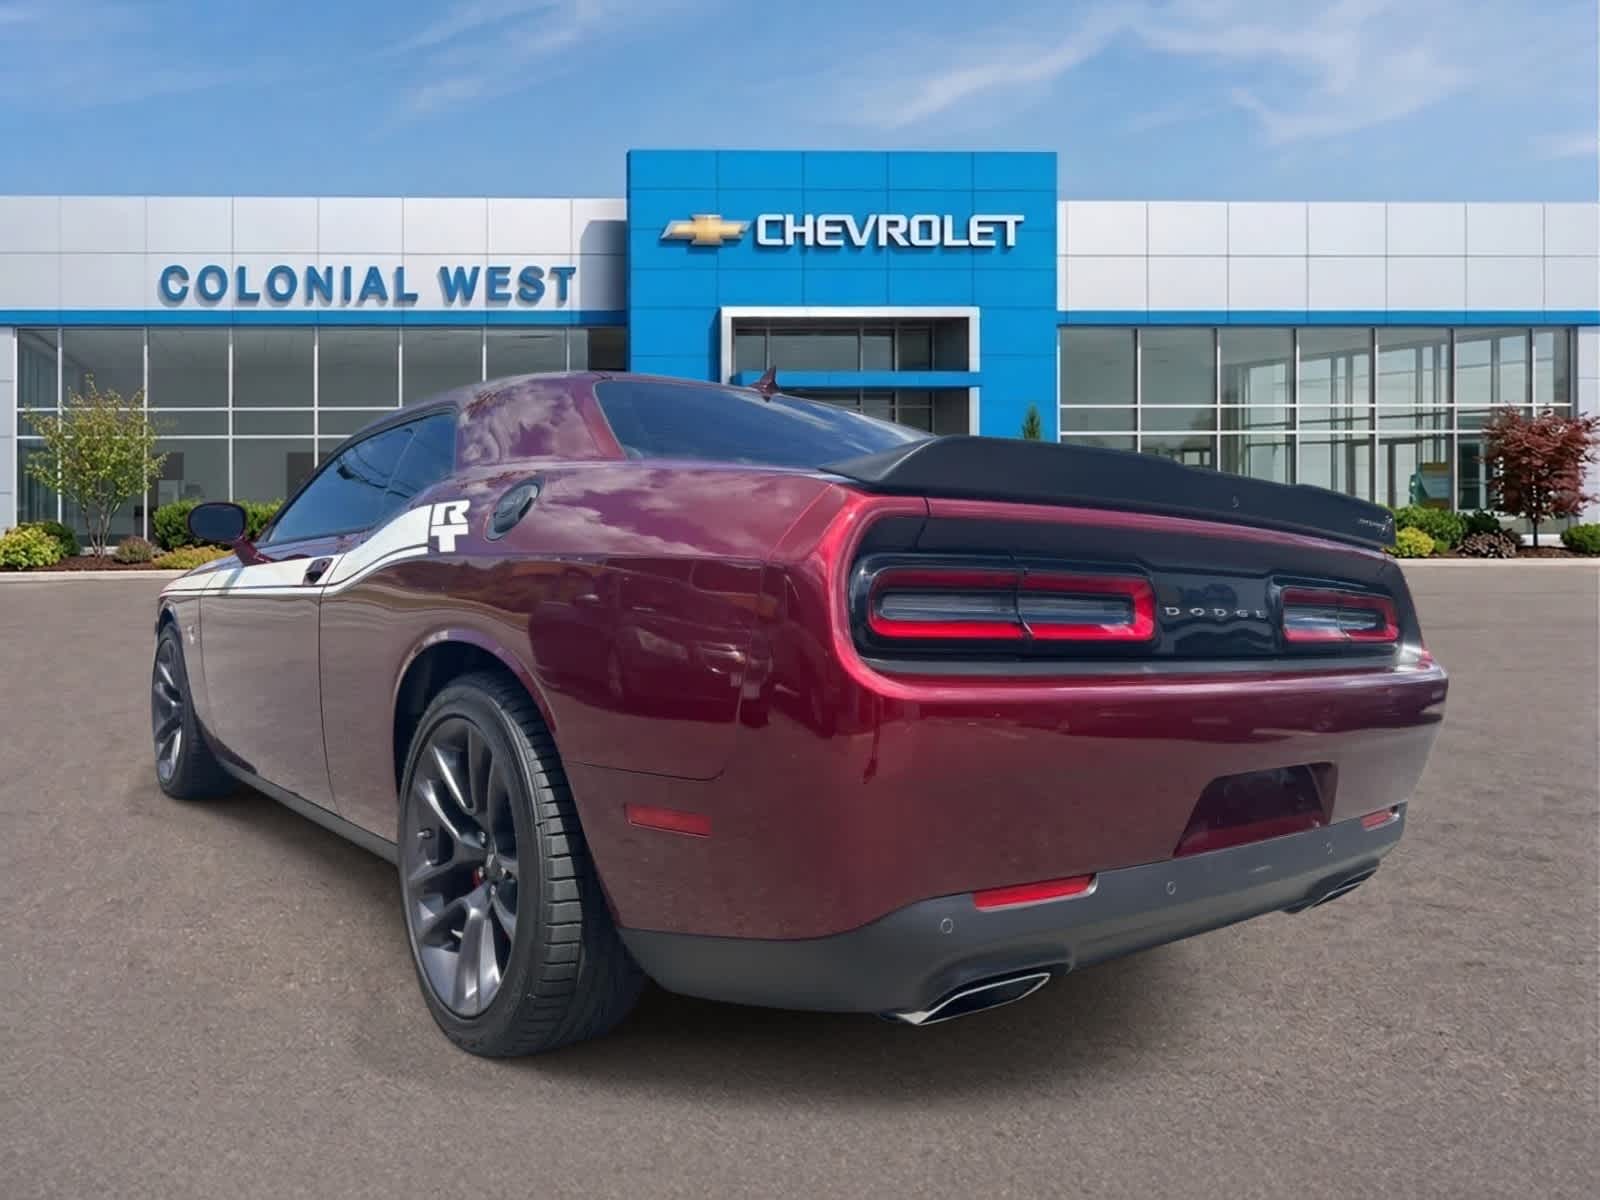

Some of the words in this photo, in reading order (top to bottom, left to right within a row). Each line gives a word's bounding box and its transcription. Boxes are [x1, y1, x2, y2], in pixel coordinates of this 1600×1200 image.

[757, 213, 1025, 247] CHEVROLET
[159, 264, 418, 303] COLONIAL
[437, 265, 577, 304] WEST
[1164, 606, 1268, 619] DODGE
